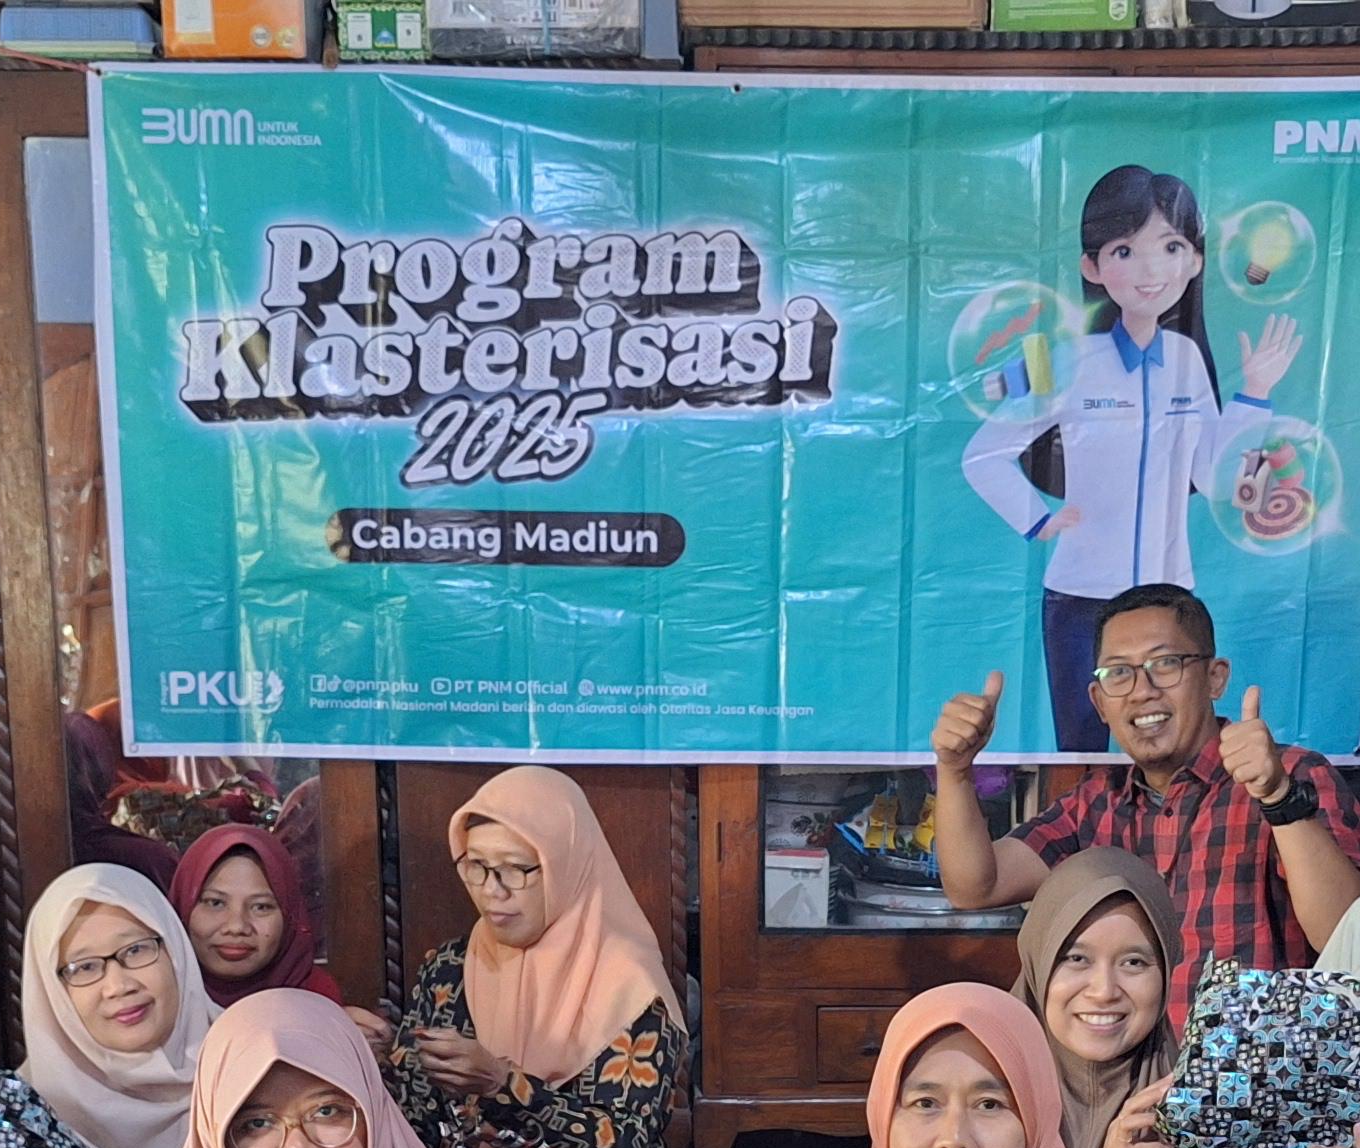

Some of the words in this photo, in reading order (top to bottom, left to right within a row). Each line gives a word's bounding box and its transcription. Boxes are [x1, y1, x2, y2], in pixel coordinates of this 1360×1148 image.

[142, 108, 254, 145] BUMN
[257, 121, 298, 133] UNTUK
[257, 135, 322, 146] INDONESIA
[261, 217, 746, 322] Program
[181, 297, 818, 403] Klasterisasi
[402, 393, 608, 485] 2025
[352, 519, 501, 557] Cabang
[515, 521, 658, 553] Madiun
[169, 671, 252, 706] PKU
[454, 681, 473, 693] PT
[478, 681, 512, 694] PNM
[516, 681, 568, 695] Official
[597, 682, 707, 697] www.pnm.co.id
[310, 698, 389, 709] Permodalan
[392, 699, 447, 711] Nasional
[450, 701, 499, 713] Madani
[548, 702, 574, 714] dan
[577, 702, 627, 714] diawasi
[630, 703, 656, 715] oleh
[660, 703, 710, 715] Otoritas
[714, 704, 745, 716] Jasa
[749, 705, 814, 718] Keuangan
